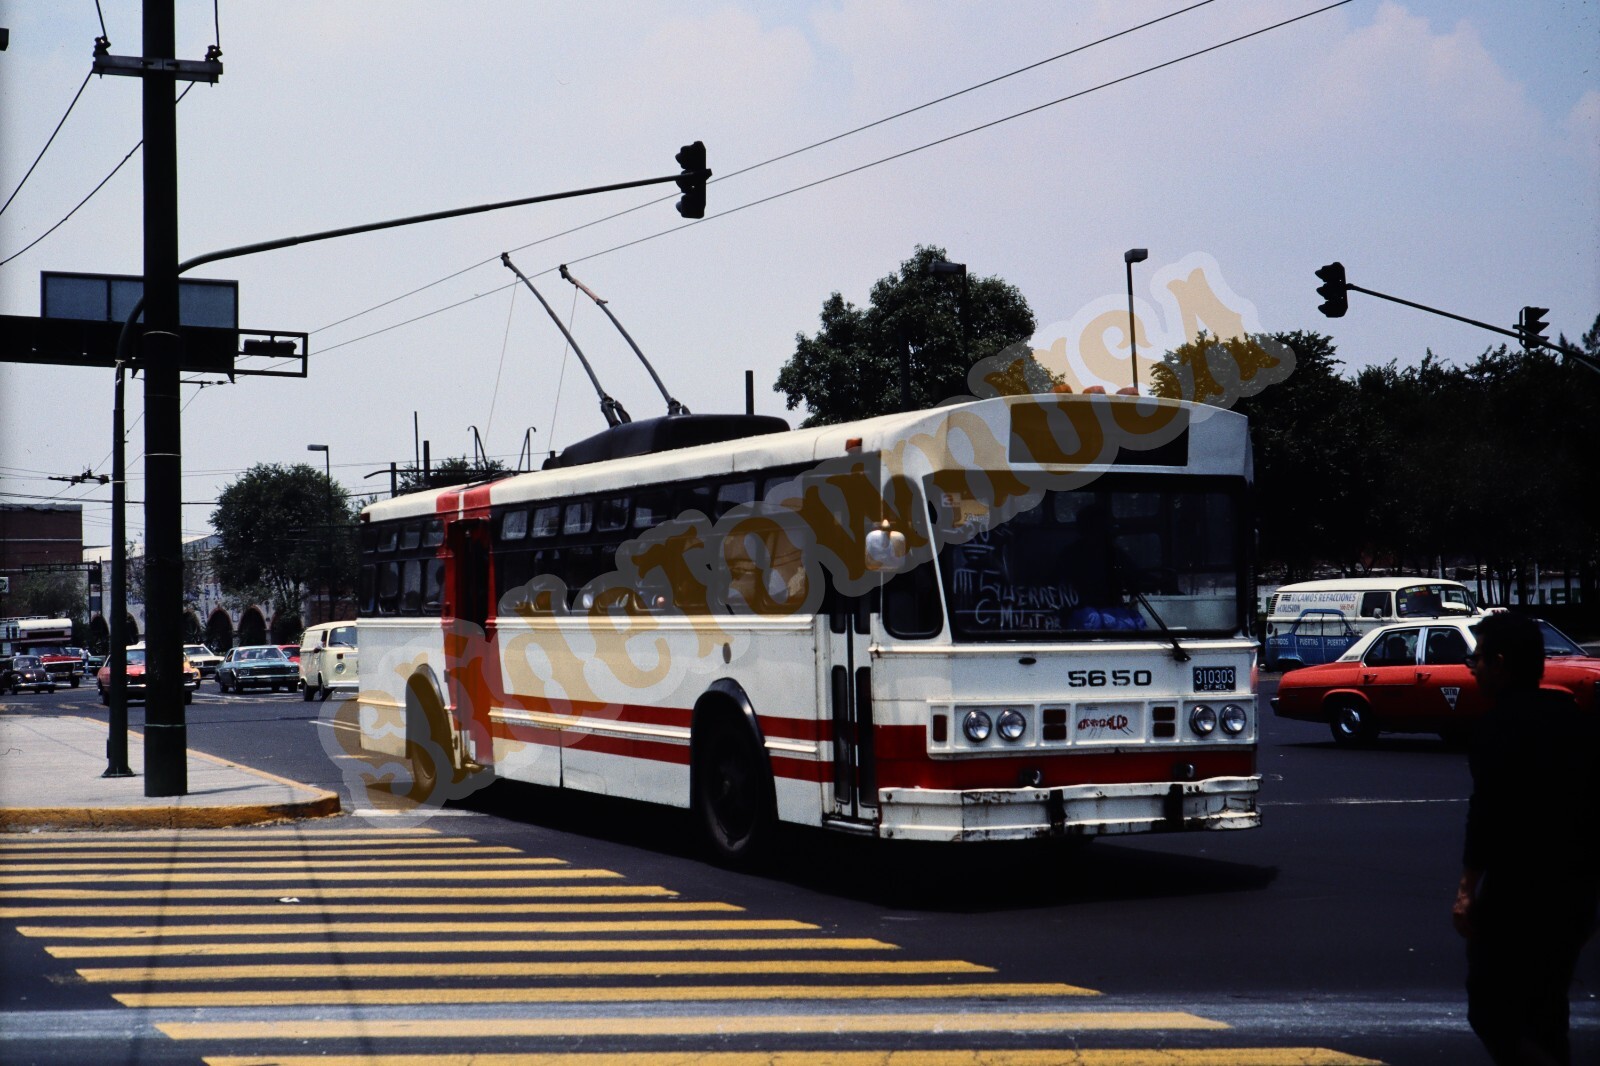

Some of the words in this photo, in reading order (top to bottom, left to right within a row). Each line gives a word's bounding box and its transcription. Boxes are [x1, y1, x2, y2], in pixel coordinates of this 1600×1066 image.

[1318, 592, 1356, 602] REFACCIONES
[1299, 637, 1319, 646] PUERTAS
[1068, 670, 1152, 687] 5650
[1196, 669, 1234, 685] 310303
